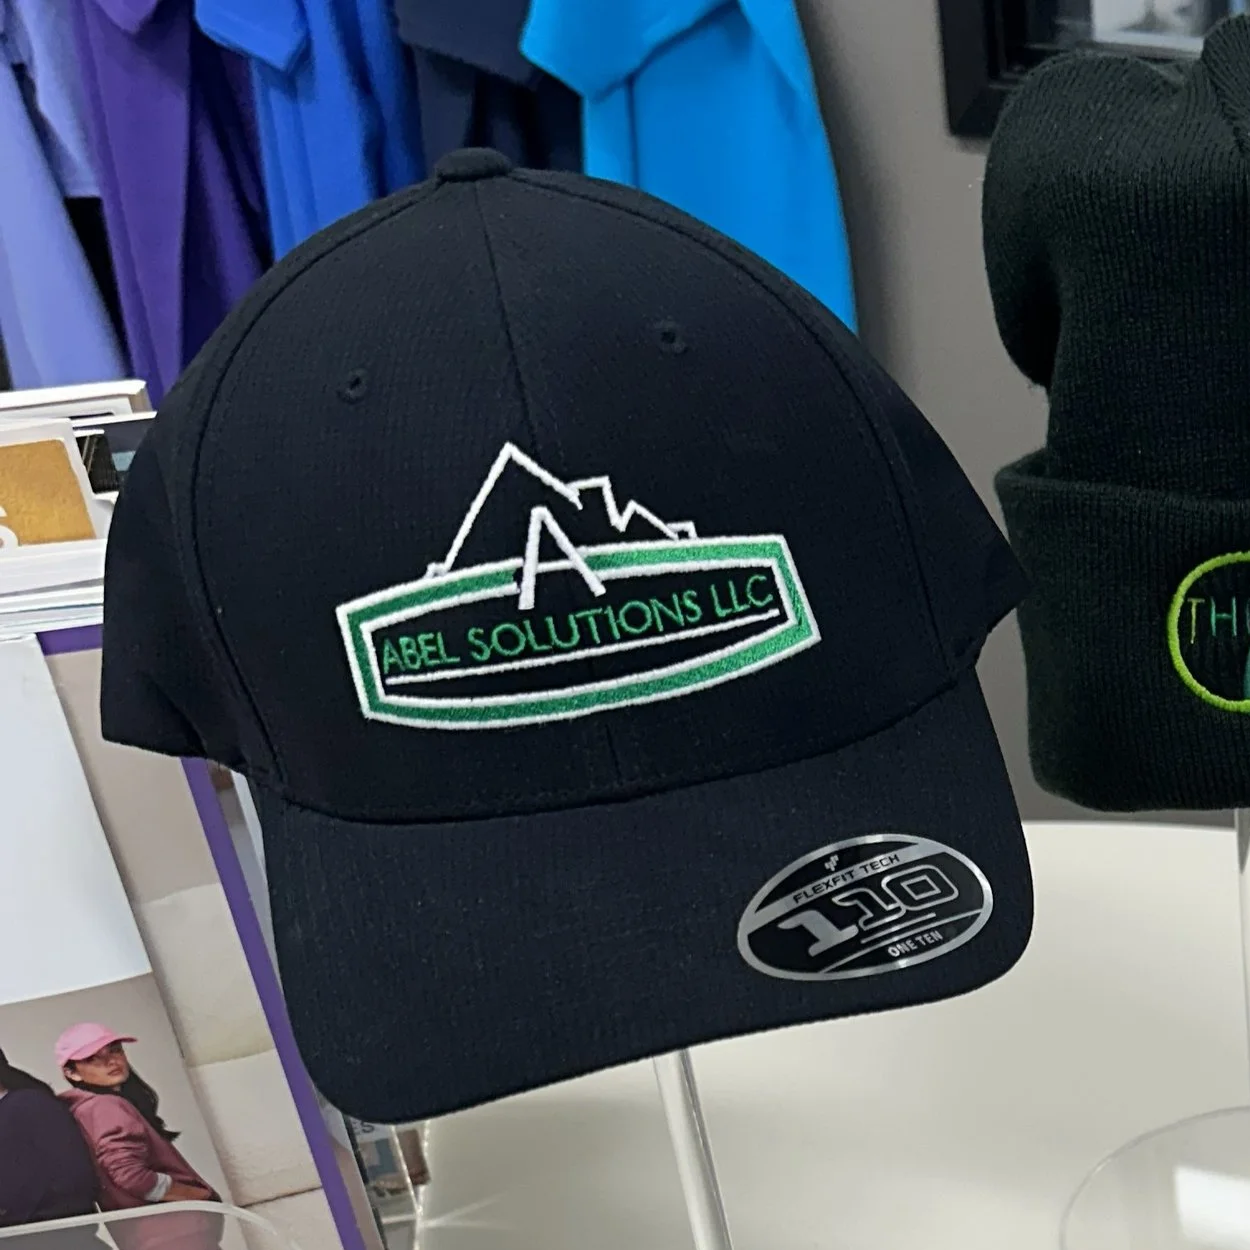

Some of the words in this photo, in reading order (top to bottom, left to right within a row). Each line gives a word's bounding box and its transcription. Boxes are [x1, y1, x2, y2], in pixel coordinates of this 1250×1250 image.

[383, 631, 460, 675] ABEL
[468, 589, 702, 663] SOLUTIONS
[711, 574, 774, 619] LLC
[776, 864, 960, 957] 110
[793, 870, 855, 904] FLEXFIT
[860, 853, 901, 875] TECH
[888, 939, 917, 957] ONE
[918, 930, 944, 947] TEN
